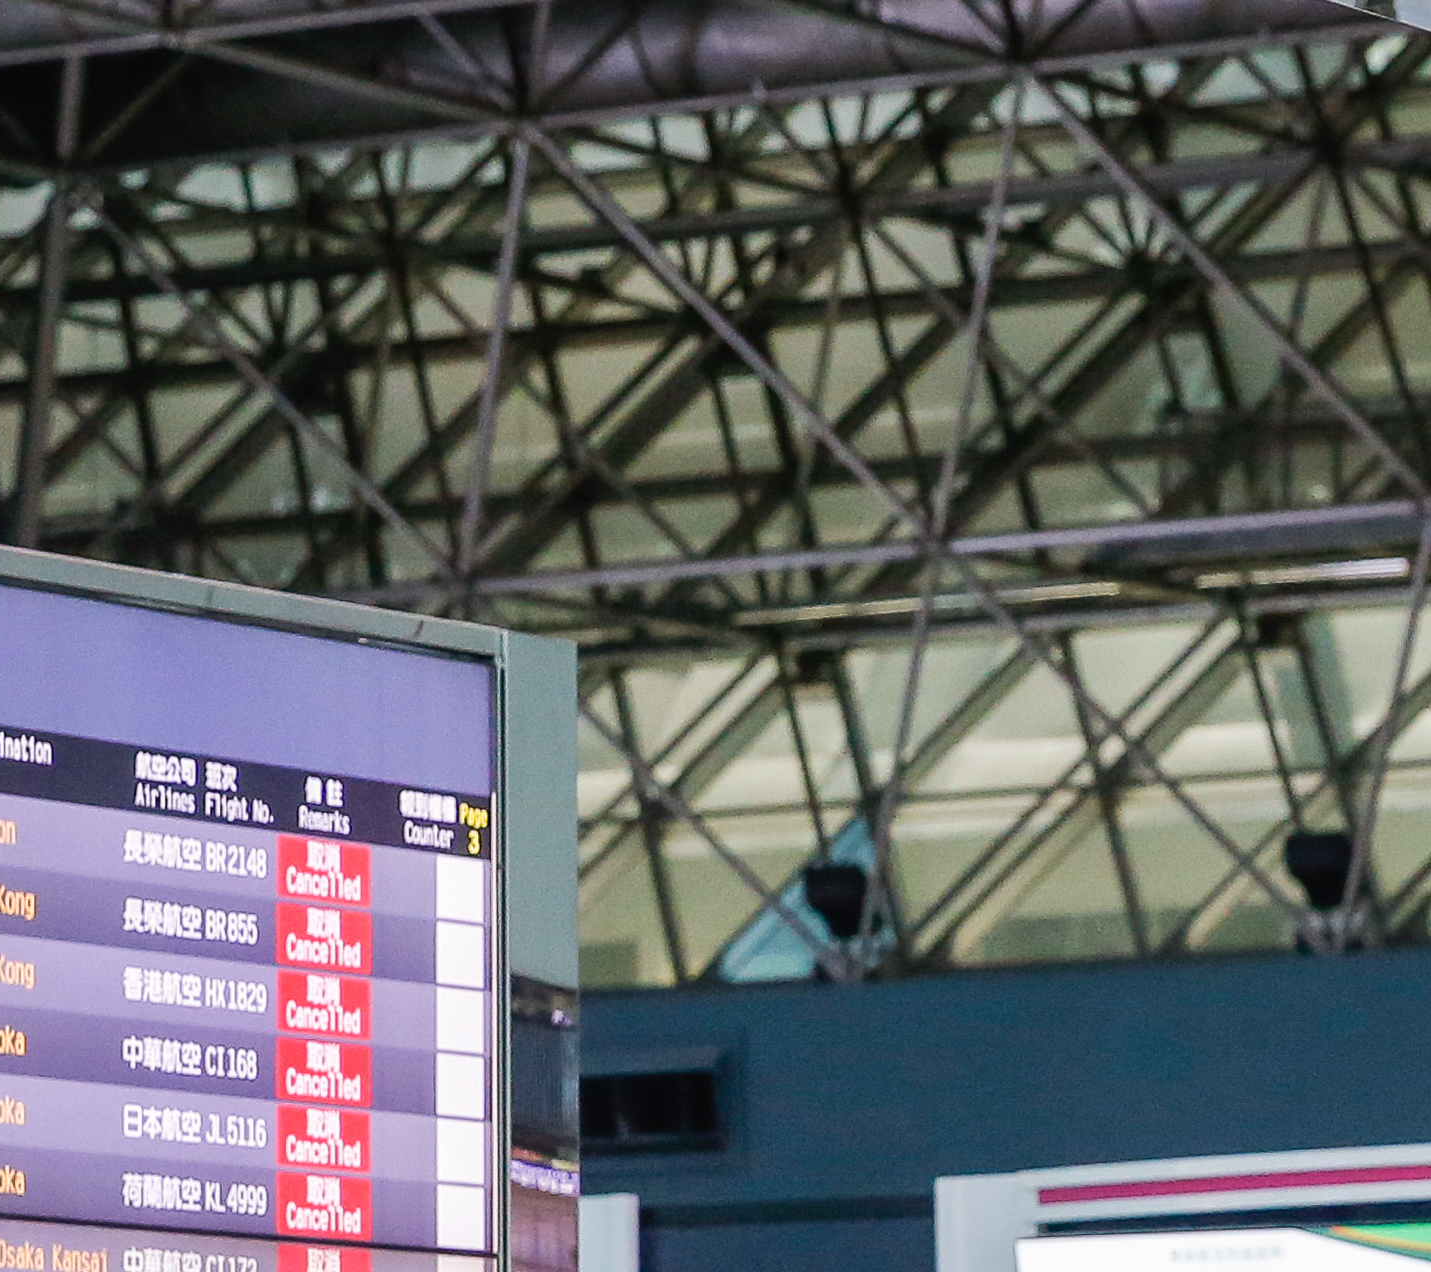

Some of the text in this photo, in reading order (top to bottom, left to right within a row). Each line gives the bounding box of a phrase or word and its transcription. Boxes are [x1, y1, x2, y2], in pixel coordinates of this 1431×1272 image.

[134, 782, 196, 816] Airlines
[204, 792, 248, 823] Flight
[252, 801, 273, 824] No.
[298, 805, 350, 836] Remarks
[404, 820, 453, 851] Counter
[467, 831, 481, 855] 3
[458, 801, 487, 831] Page
[285, 866, 361, 903] Cancelled
